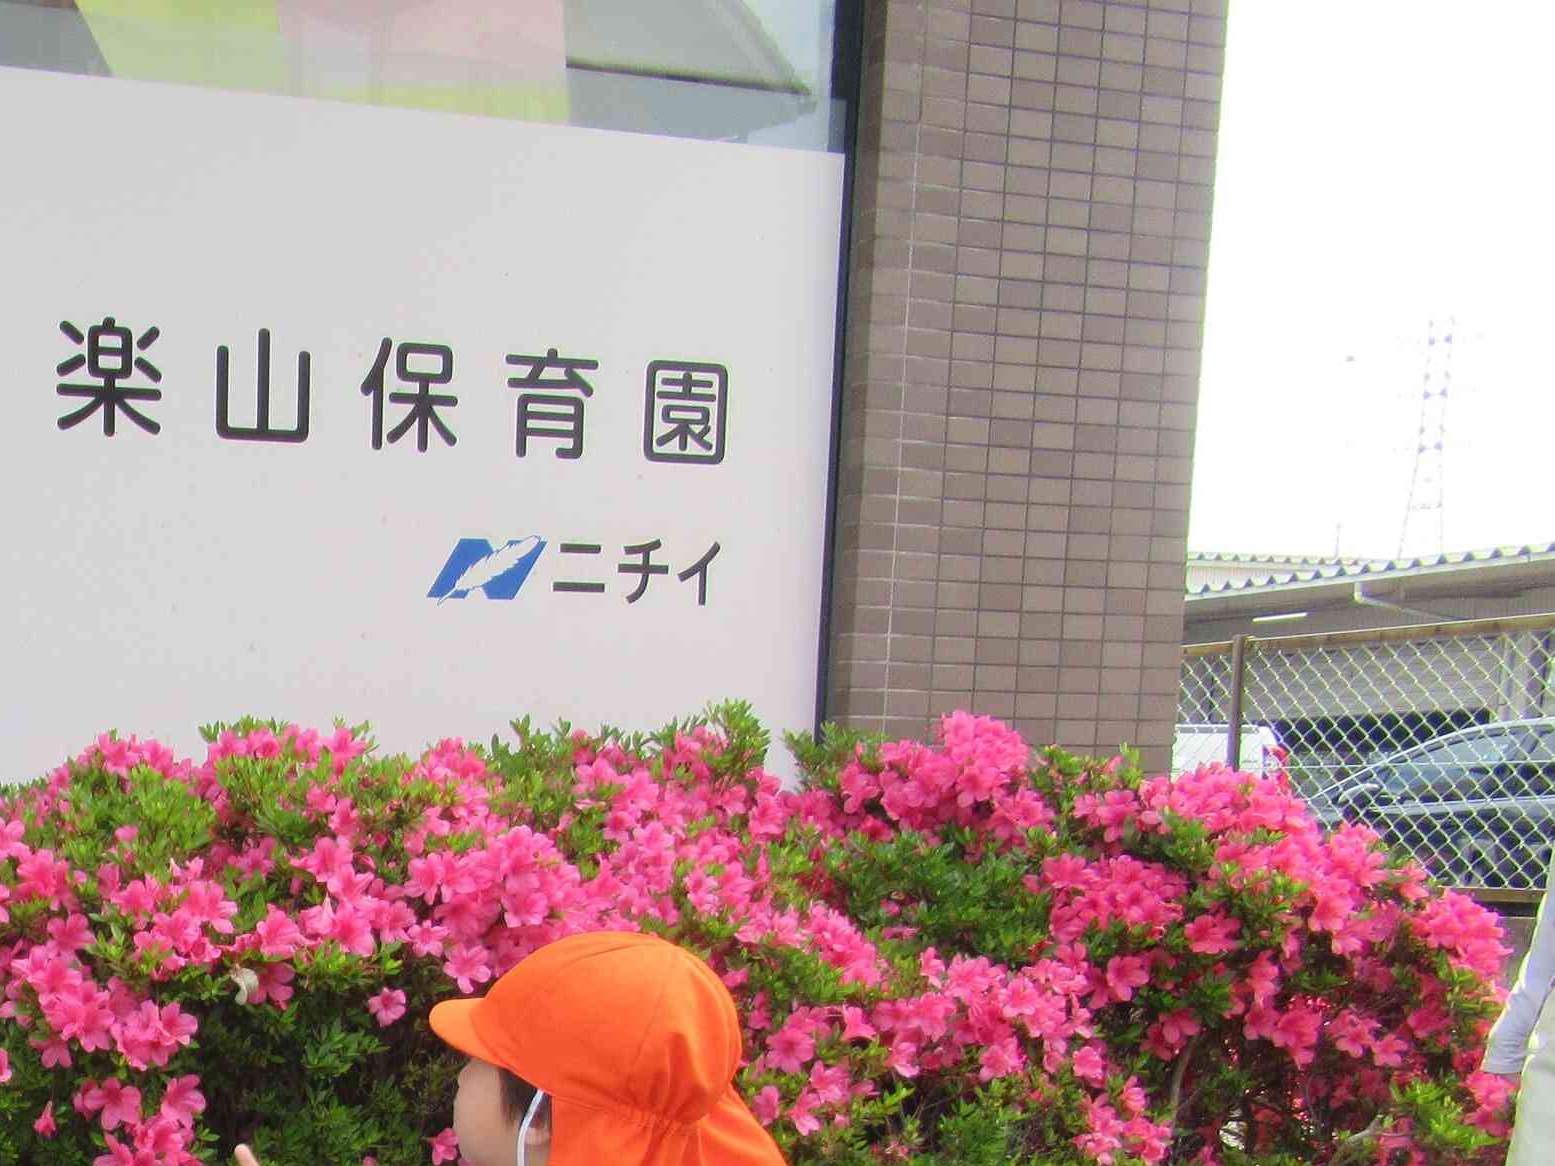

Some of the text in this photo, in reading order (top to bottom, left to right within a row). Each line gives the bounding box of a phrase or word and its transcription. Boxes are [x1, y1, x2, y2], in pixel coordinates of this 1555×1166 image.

[55, 316, 729, 466] 楽山保育園
[552, 537, 722, 607] ニチイ
